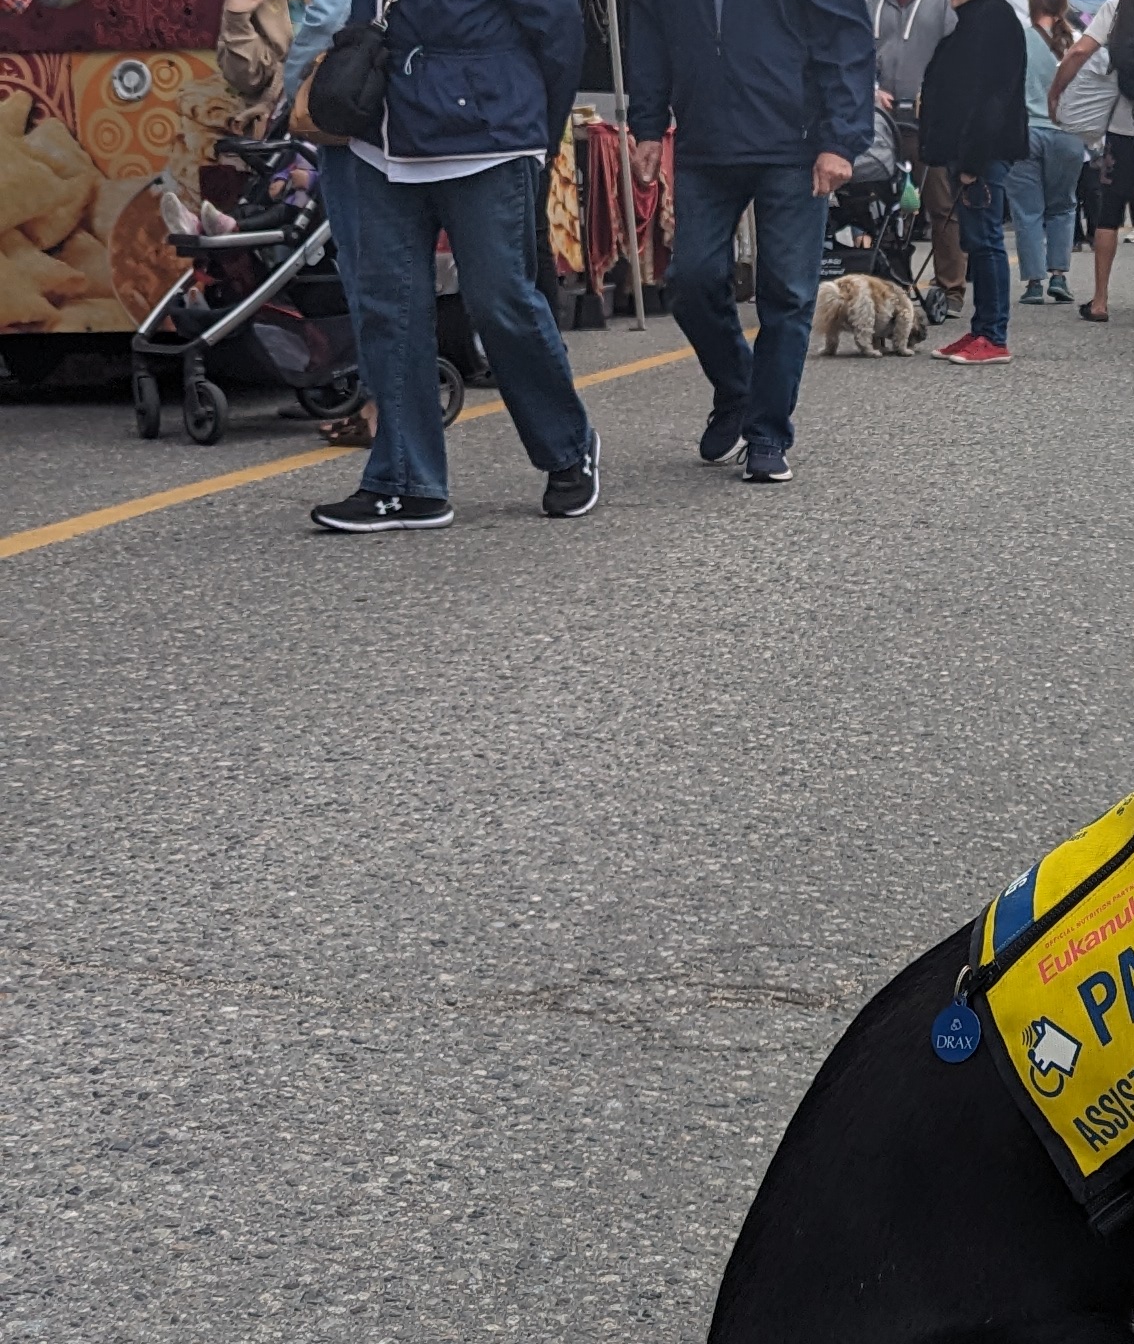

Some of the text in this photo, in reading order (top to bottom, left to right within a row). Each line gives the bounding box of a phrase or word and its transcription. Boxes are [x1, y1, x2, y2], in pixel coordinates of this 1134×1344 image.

[1044, 926, 1075, 949] OFFICIAL
[1076, 900, 1112, 929] NUTRITION
[936, 1034, 974, 1050] DRAX
